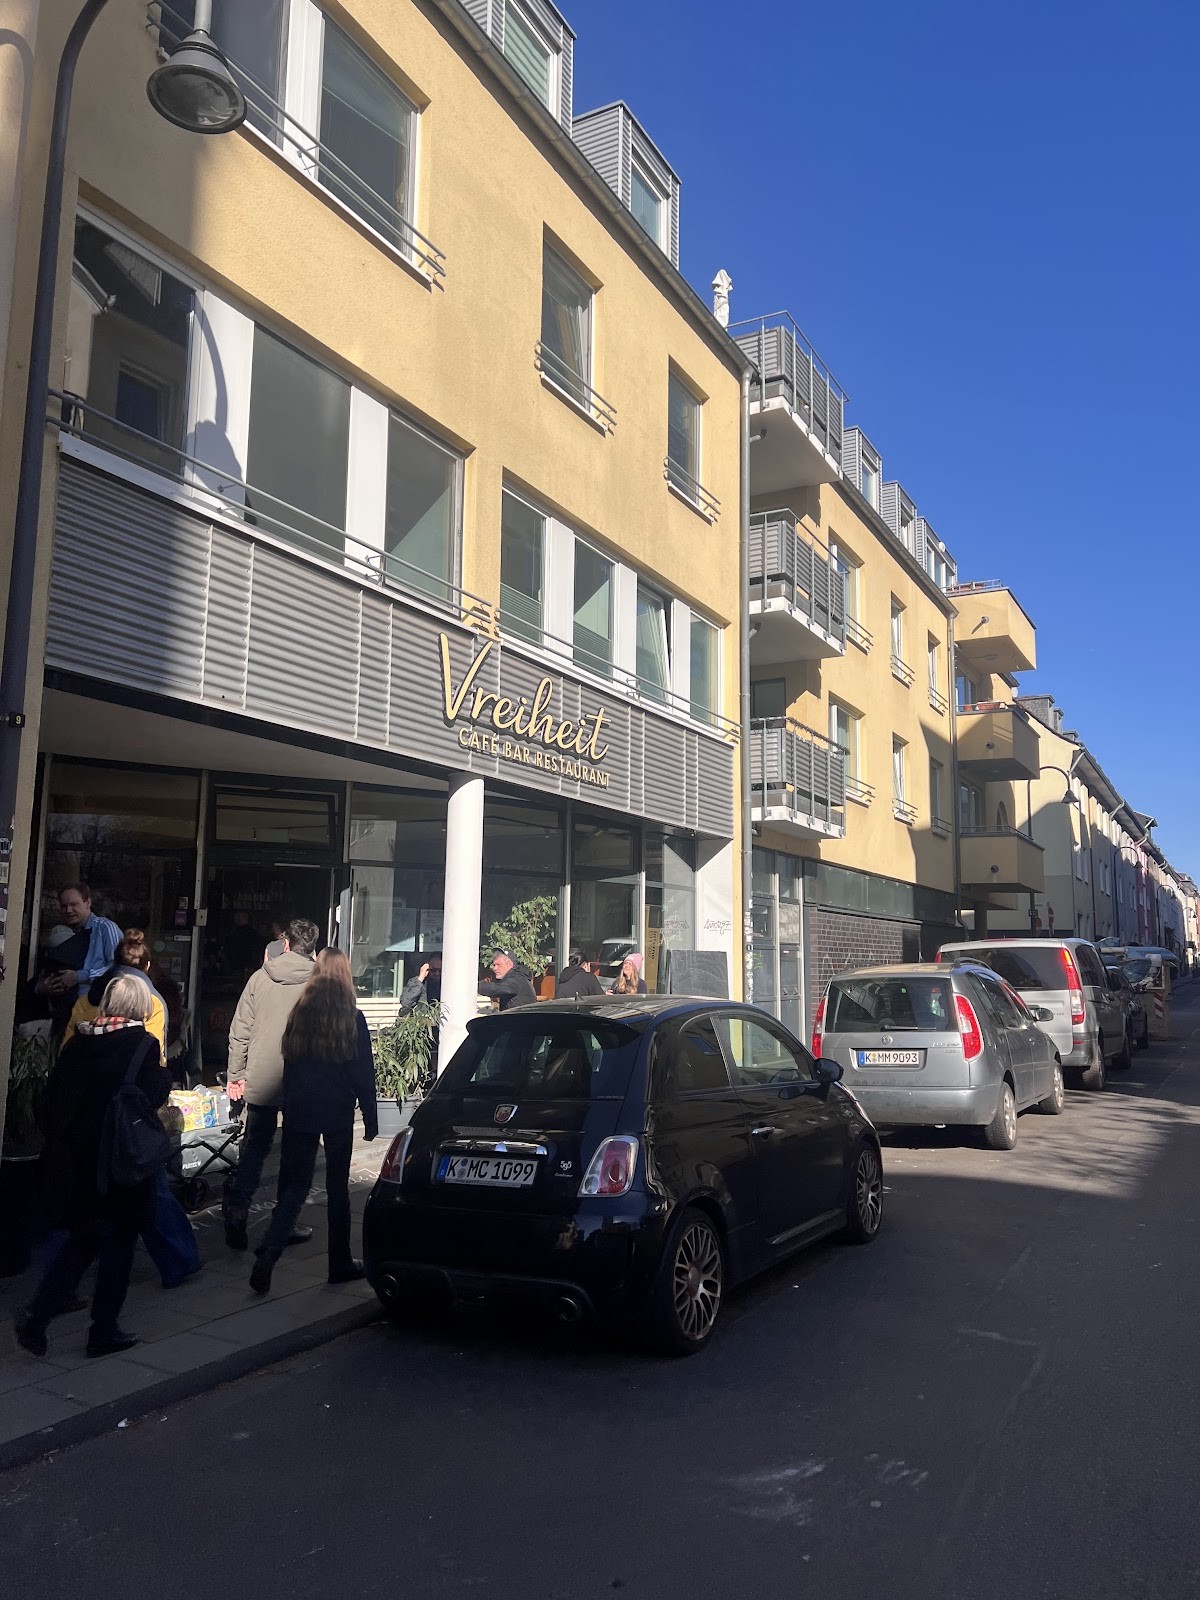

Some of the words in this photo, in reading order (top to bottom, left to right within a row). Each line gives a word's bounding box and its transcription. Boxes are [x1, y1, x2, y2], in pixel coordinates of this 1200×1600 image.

[438, 632, 612, 760] Vreiheit
[459, 728, 498, 755] CAFÉ
[505, 741, 530, 764] BAR
[536, 751, 611, 787] RESTAURANT
[865, 1053, 872, 1062] K
[878, 1053, 891, 1062] MM
[892, 1053, 918, 1062] 9093
[446, 1160, 460, 1177] K
[467, 1160, 490, 1179] MC
[490, 1162, 534, 1182] 1099
